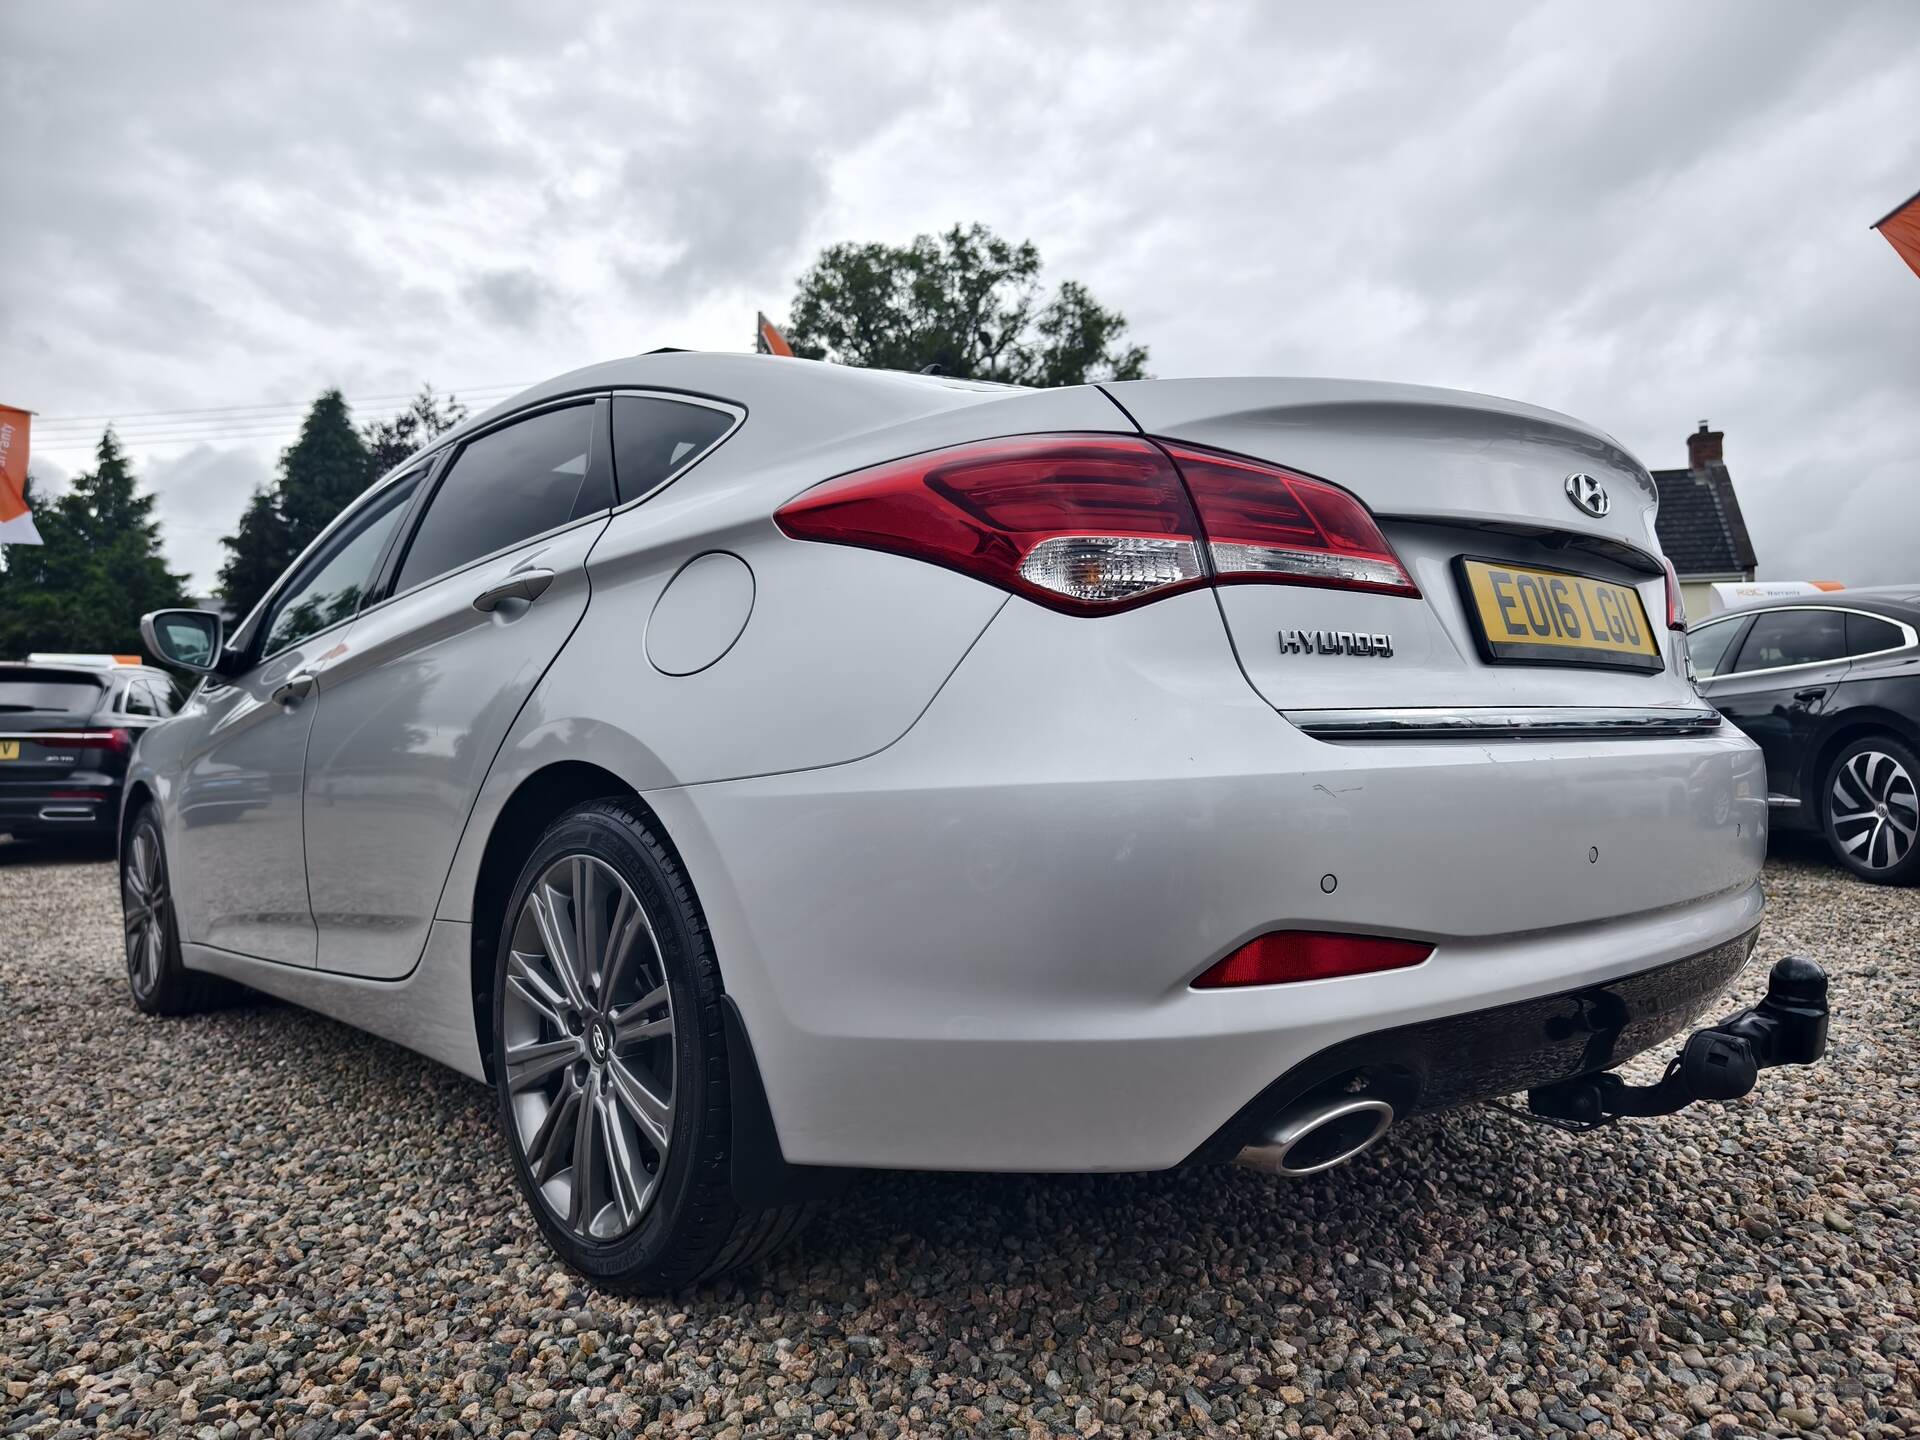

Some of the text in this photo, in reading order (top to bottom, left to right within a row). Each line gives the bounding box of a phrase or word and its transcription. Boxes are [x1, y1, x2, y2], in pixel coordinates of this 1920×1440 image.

[1488, 571, 1641, 646] EO16 LGU
[1279, 630, 1393, 657] HYUNDAI
[2, 741, 11, 755] V
